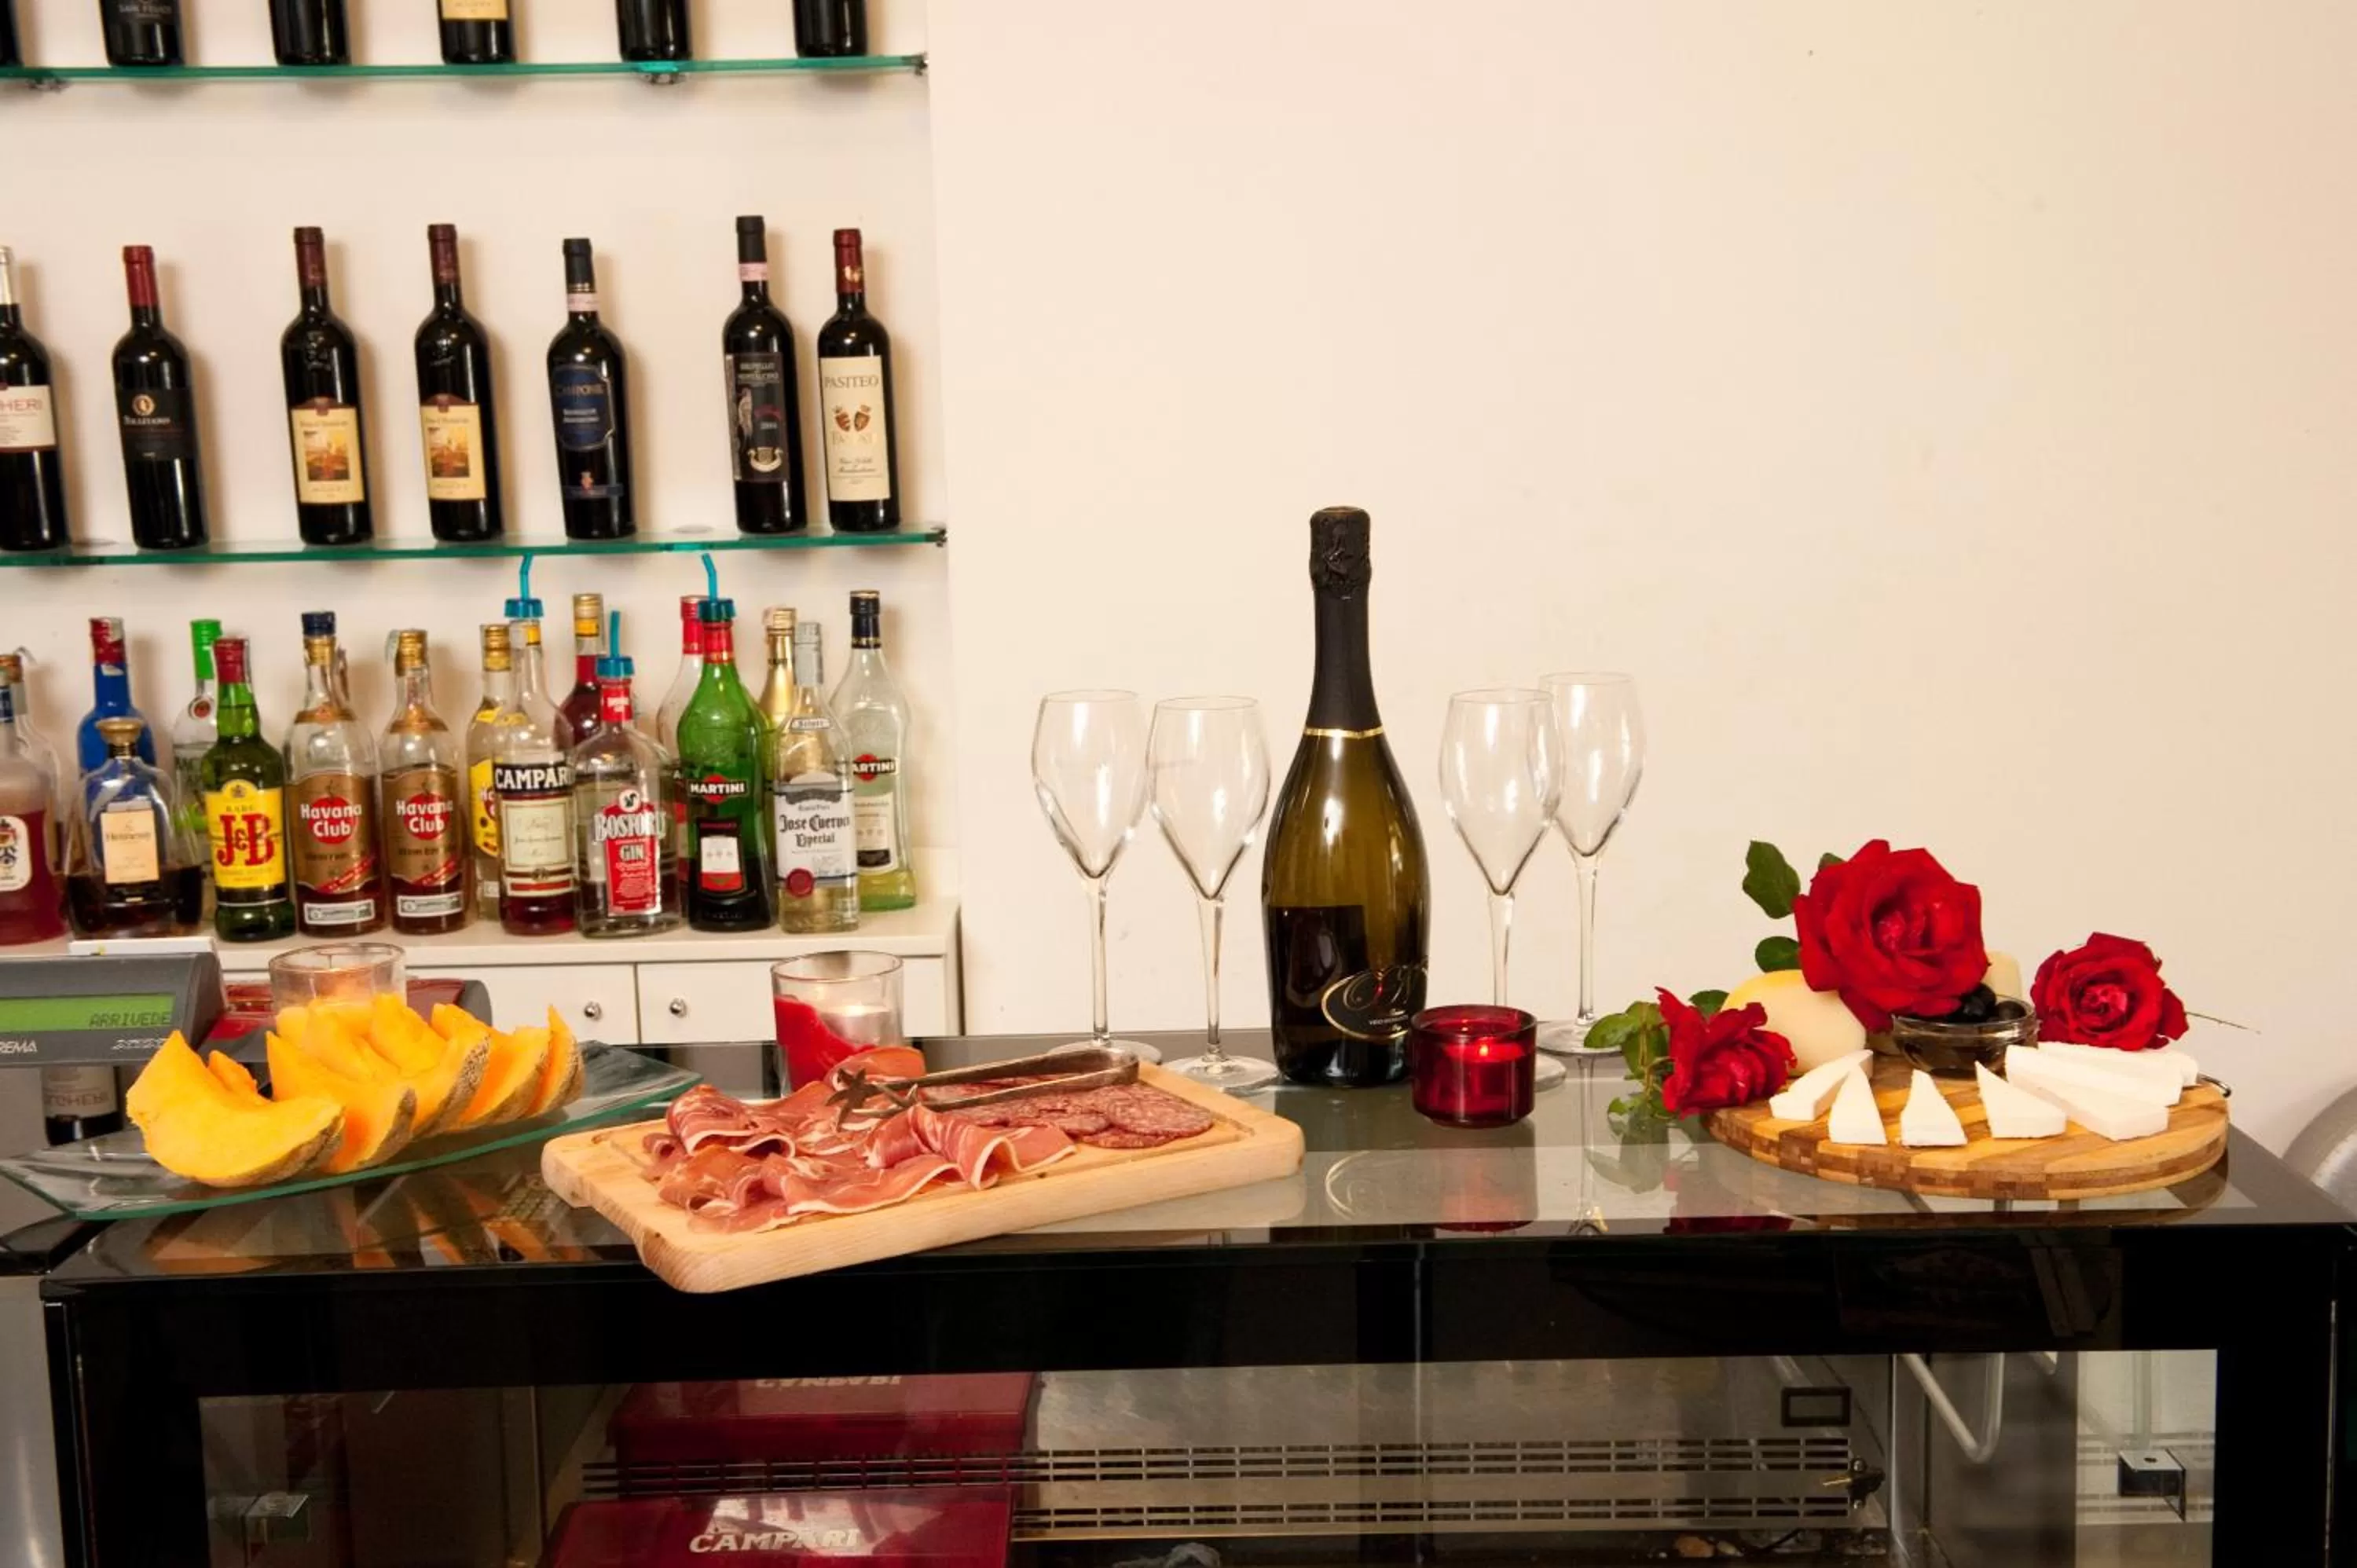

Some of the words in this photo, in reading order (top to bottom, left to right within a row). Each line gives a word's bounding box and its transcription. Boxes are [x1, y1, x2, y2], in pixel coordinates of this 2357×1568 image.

[824, 375, 879, 389] PASITEO
[689, 782, 745, 795] MARTINI
[300, 804, 362, 819] Havana
[395, 800, 453, 815] Havana
[313, 820, 351, 837] Club
[409, 816, 445, 833] Club
[779, 815, 807, 833] Jose
[217, 813, 275, 867] J&B
[620, 844, 644, 862] GIN
[89, 1011, 173, 1028] ARRIVEDE
[689, 1529, 860, 1554] CAMPARI
